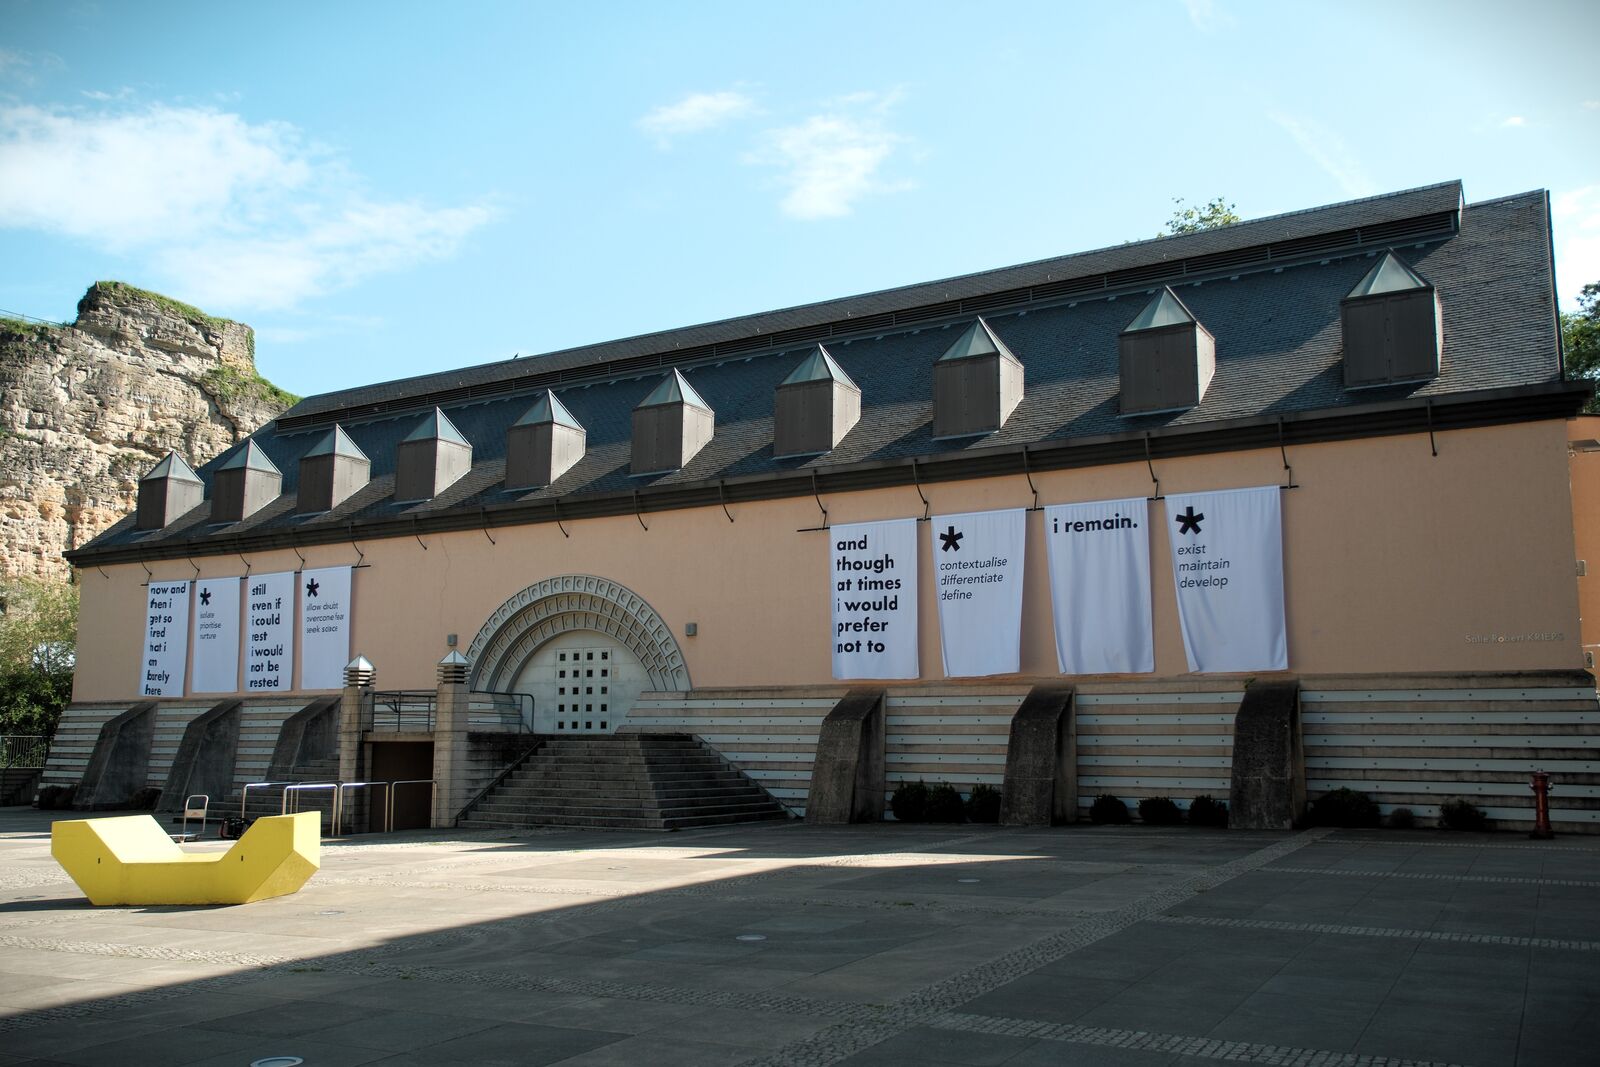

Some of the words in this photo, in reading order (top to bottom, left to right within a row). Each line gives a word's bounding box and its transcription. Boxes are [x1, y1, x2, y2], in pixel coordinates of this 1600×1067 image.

[1054, 518, 1058, 533] i
[1065, 513, 1138, 532] remain.
[837, 535, 867, 551] and
[1177, 544, 1206, 555] exist
[837, 554, 894, 573] though
[940, 557, 1007, 571] contextualise
[1179, 559, 1230, 572] maintain
[838, 578, 852, 592] at
[858, 576, 901, 591] times
[941, 573, 1003, 586] differentiate
[1180, 575, 1228, 589] develop
[150, 586, 168, 594] now
[171, 583, 186, 594] and
[252, 584, 266, 595] still
[942, 590, 973, 601] define
[252, 603, 272, 611] even
[275, 597, 281, 609] if
[845, 595, 898, 611] would
[256, 614, 280, 626] could
[838, 617, 888, 637] prefer
[252, 632, 268, 641] rest
[255, 644, 283, 656] would
[838, 640, 862, 653] not
[868, 640, 885, 652] to
[250, 662, 264, 672] not
[268, 660, 279, 671] be
[147, 670, 170, 684] barely
[249, 676, 278, 687] rested
[145, 684, 161, 695] here
